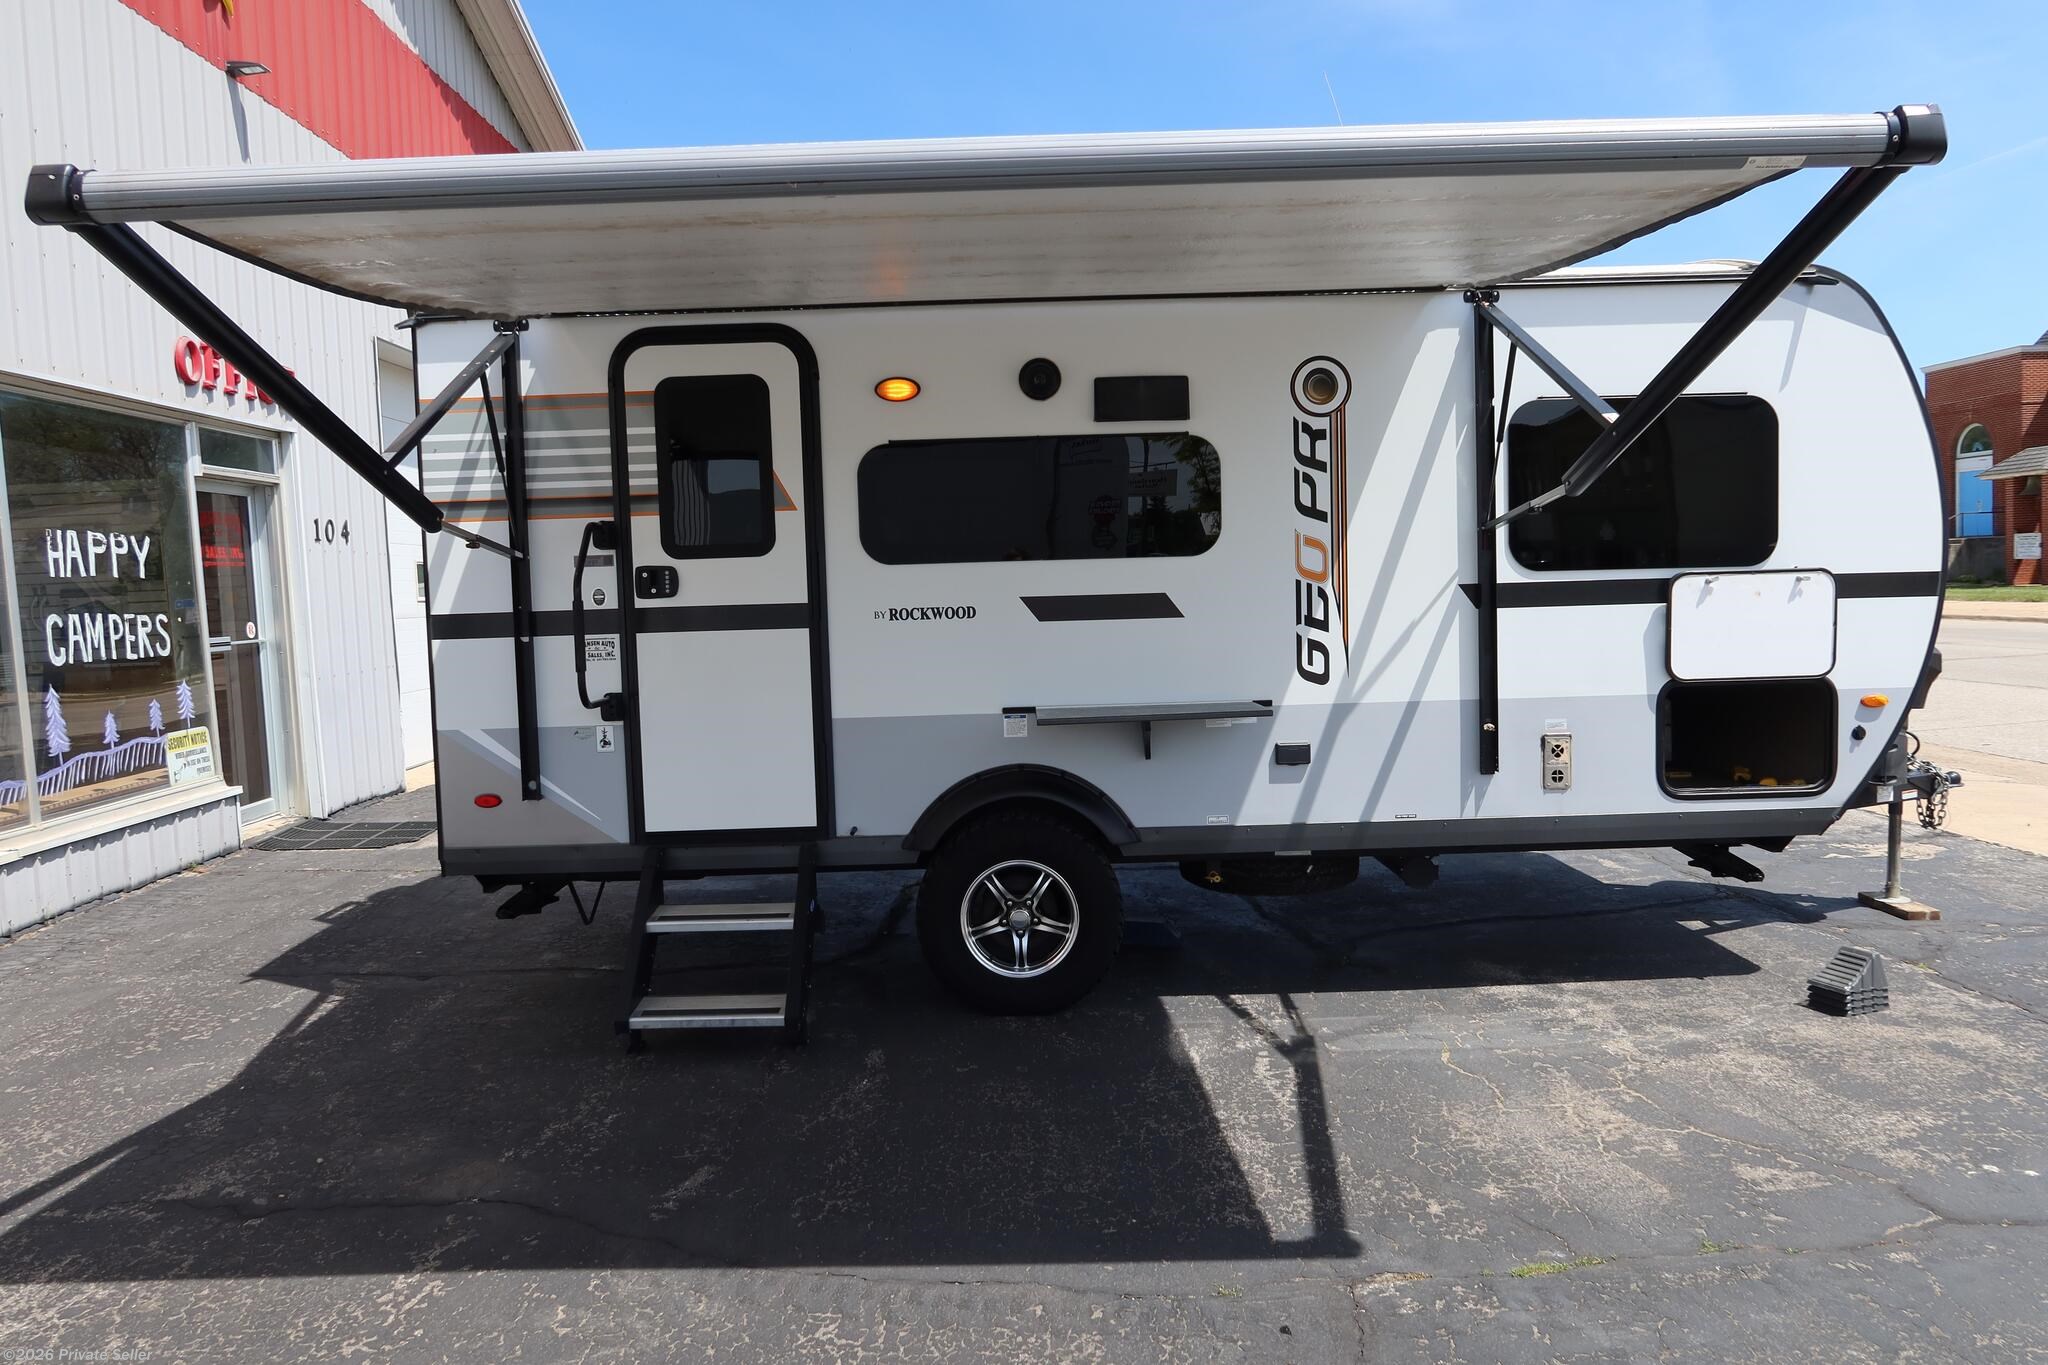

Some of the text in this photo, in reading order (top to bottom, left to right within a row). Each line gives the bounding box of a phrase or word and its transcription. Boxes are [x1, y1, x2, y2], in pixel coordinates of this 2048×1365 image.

[313, 518, 350, 546] 104
[45, 528, 151, 580] HAPPY
[874, 606, 977, 621] BY ROCKWOOD
[46, 612, 171, 667] CAMPERS
[168, 731, 207, 751] SECURITY NOTICE
